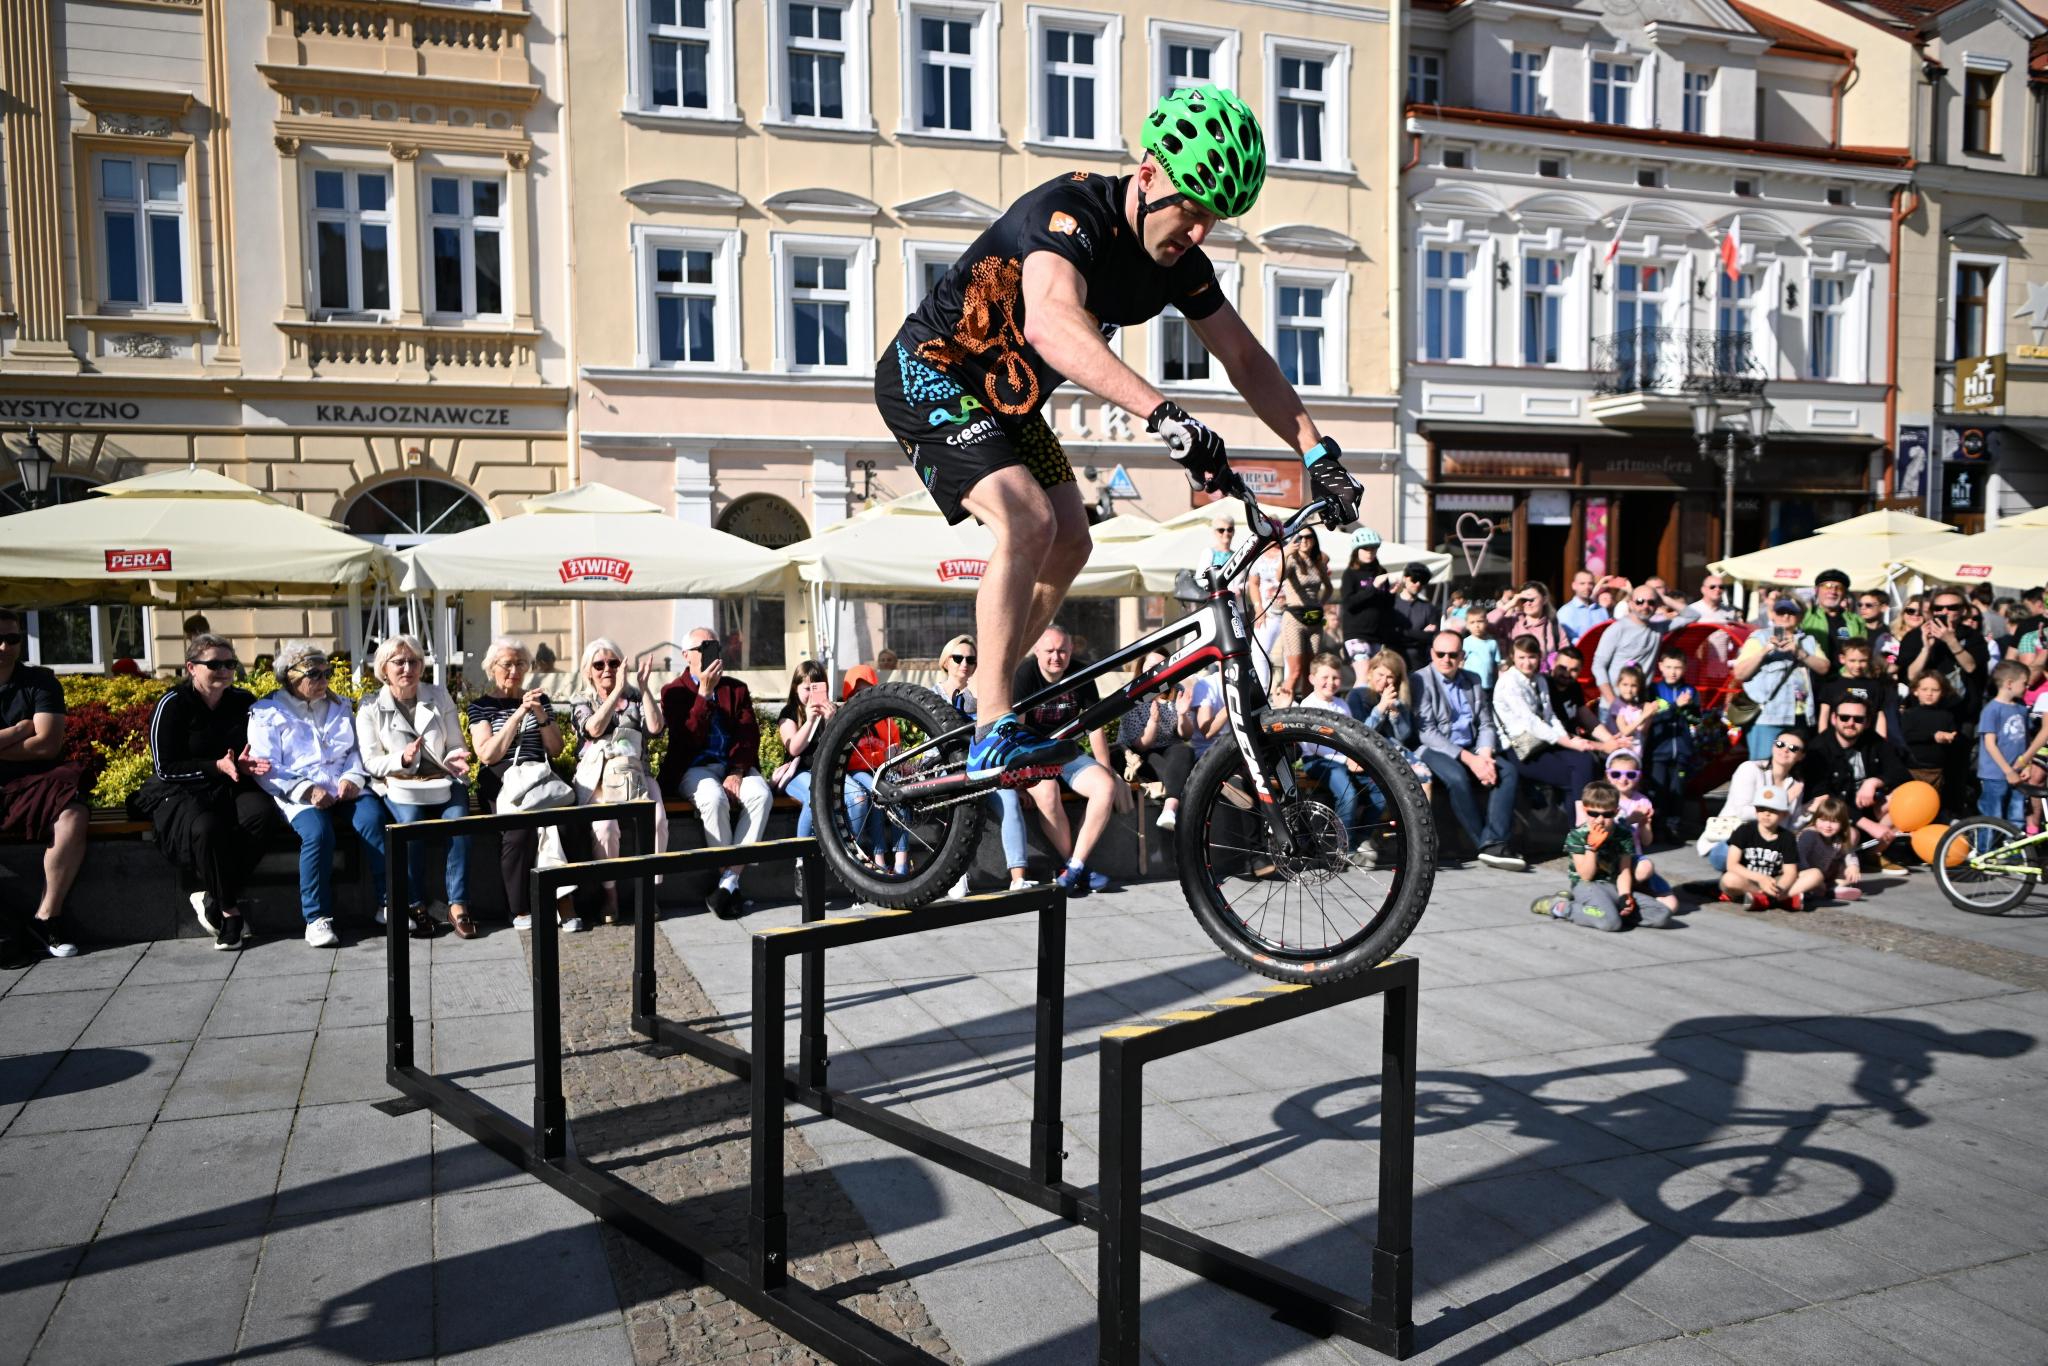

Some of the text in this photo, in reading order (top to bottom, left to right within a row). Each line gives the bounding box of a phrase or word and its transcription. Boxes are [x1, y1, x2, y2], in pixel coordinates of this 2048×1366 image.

[1153, 142, 1181, 188] catlike
[316, 404, 510, 425] KRAJOZNAWCZE
[111, 552, 167, 568] PERŁA
[568, 559, 625, 576] ŻYWIEC
[945, 560, 988, 576] ŻYWIE
[1226, 683, 1270, 796] CLEAN
